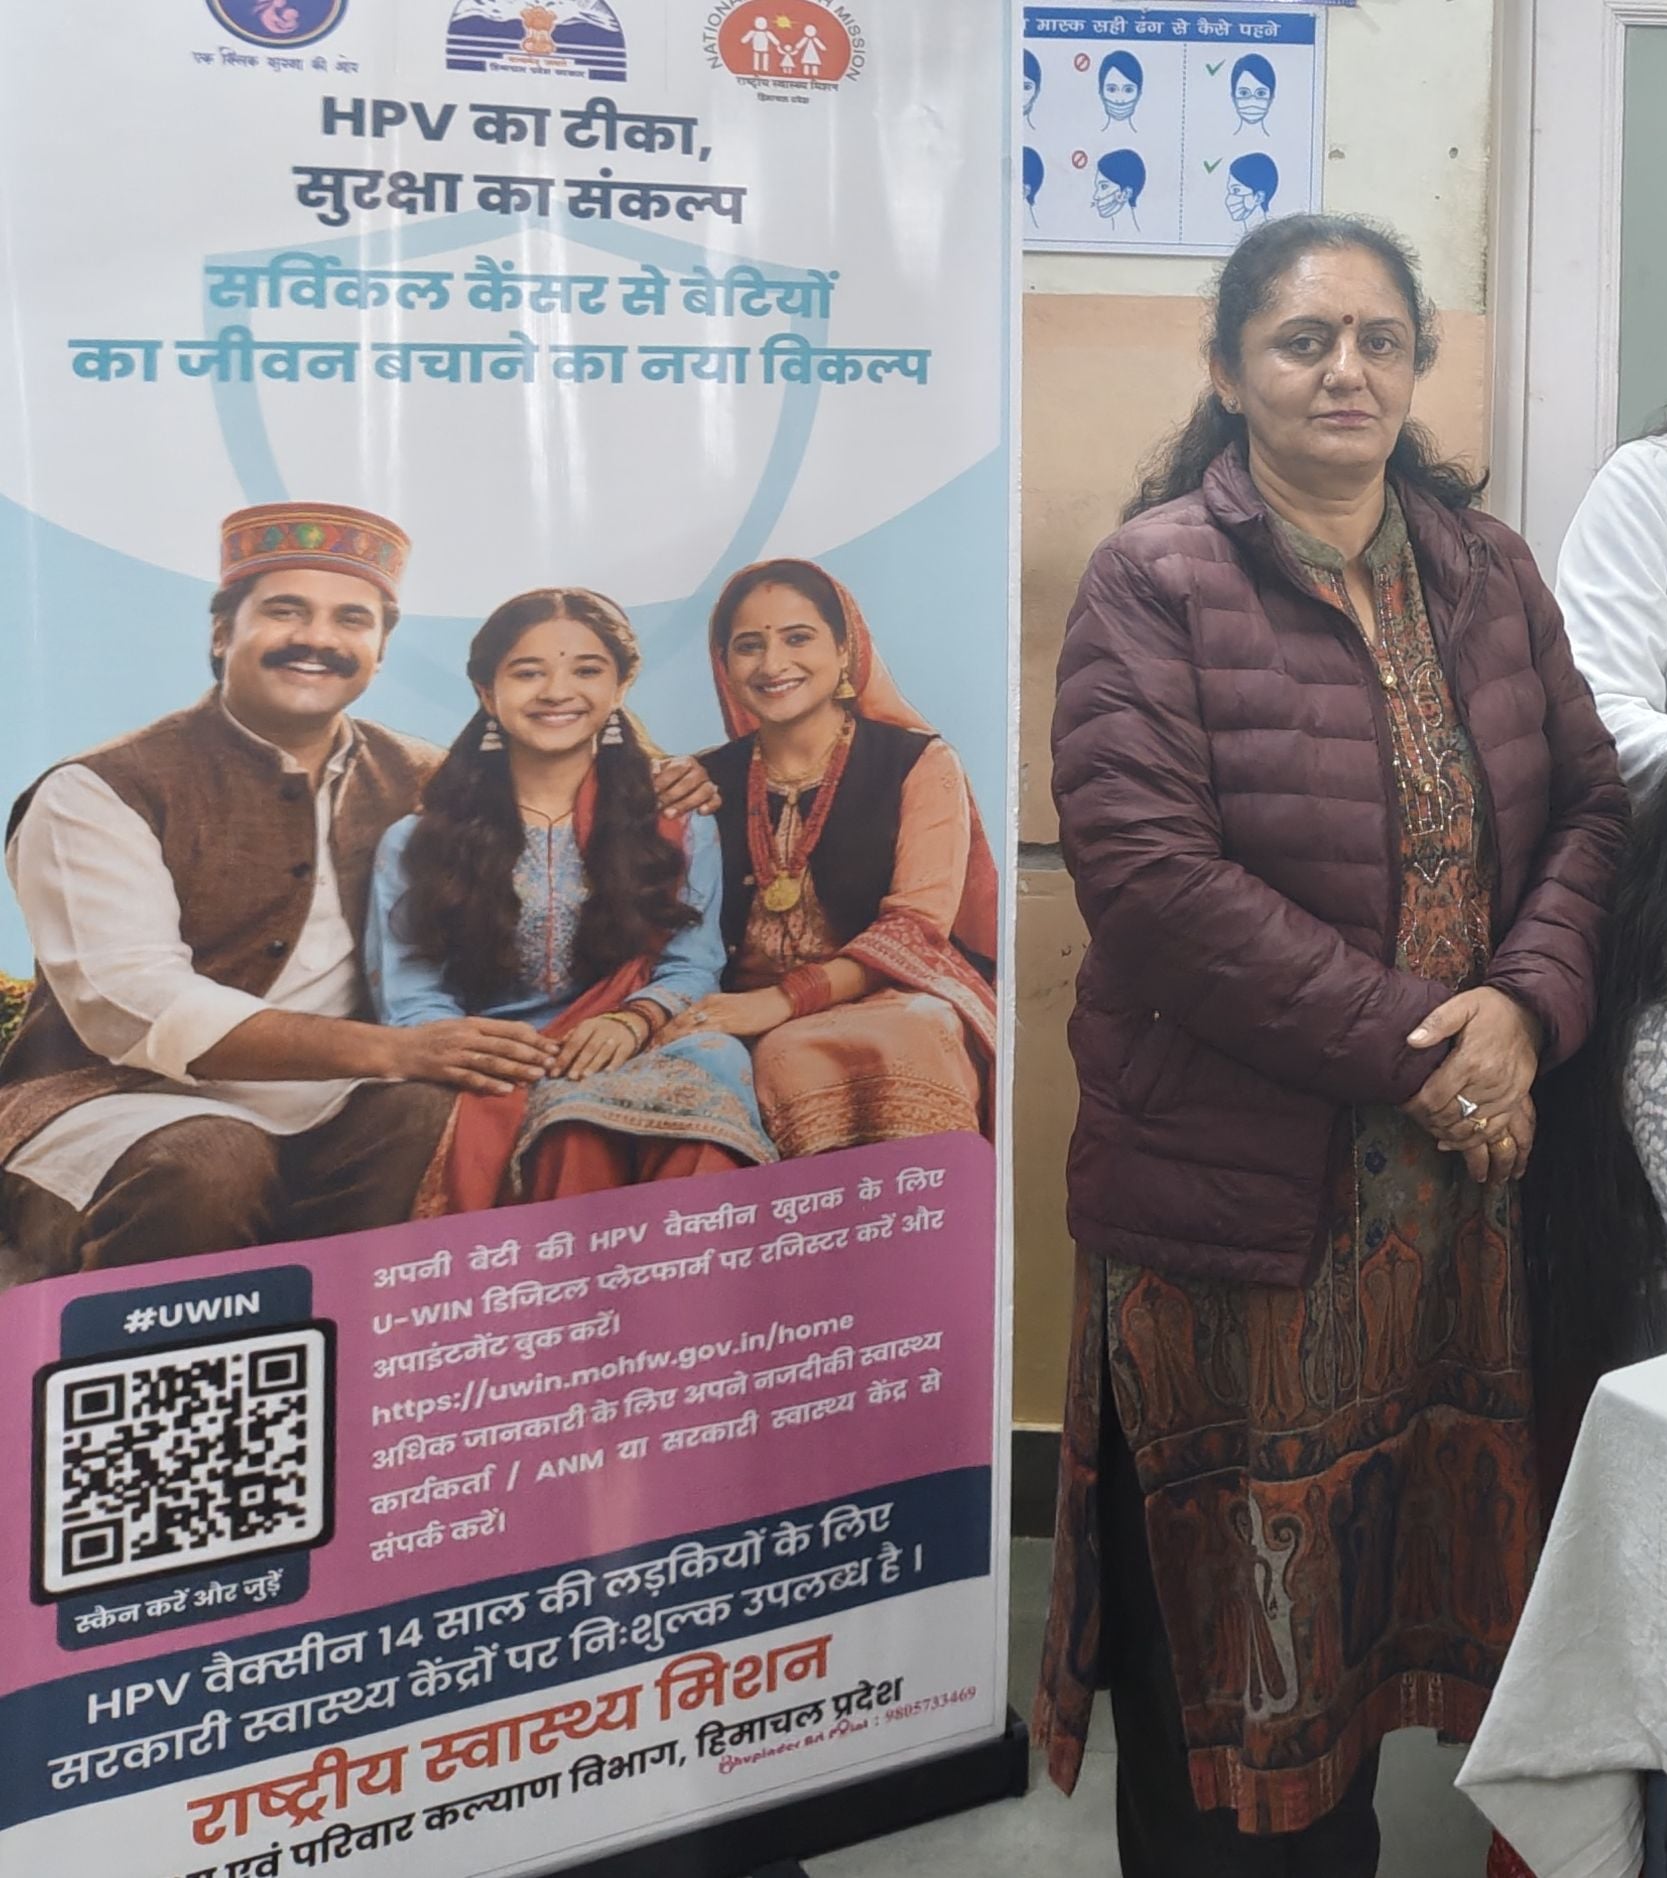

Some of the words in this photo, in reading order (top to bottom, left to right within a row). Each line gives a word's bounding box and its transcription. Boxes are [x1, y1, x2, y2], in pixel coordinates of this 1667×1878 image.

[1036, 19, 1084, 33] मास्क
[1093, 17, 1128, 34] सही
[1135, 16, 1164, 35] ढंग
[1172, 18, 1190, 35] से
[1197, 16, 1231, 37] कैसे
[320, 96, 457, 145] HPV
[470, 102, 551, 148] का
[563, 96, 712, 162] टीका,
[292, 163, 462, 228] सुरक्षा
[474, 171, 561, 218] का
[567, 165, 747, 226] संकल्प
[205, 251, 454, 310] सर्विकल
[464, 254, 611, 317] कैंसर
[620, 263, 668, 317] से
[681, 266, 842, 322] बेटियों
[68, 339, 163, 382] का
[174, 324, 361, 383] जीवन
[370, 330, 539, 384] बचाने
[554, 339, 630, 386] का
[639, 341, 747, 387] नया
[762, 333, 932, 389] विकल्प
[372, 1297, 473, 1335] U-WIN
[481, 1277, 590, 1315] डिजिटल
[596, 1247, 717, 1291] प्लेटफार्म
[719, 1247, 754, 1271] पर
[761, 1227, 850, 1265] रजिस्टर
[855, 1212, 897, 1243] करें
[901, 1205, 945, 1234] और
[373, 1250, 453, 1289] अपनी
[468, 1240, 521, 1271] बेटी
[535, 1231, 575, 1261] की
[589, 1223, 649, 1253] HPV
[663, 1202, 758, 1238] वैक्सीन
[771, 1187, 845, 1224] खुराक
[857, 1176, 883, 1201] के
[896, 1166, 946, 1196] लिए
[123, 1291, 260, 1335] #UWIN
[373, 1332, 509, 1379] अपाइंटमेंट
[513, 1325, 565, 1360] बुक
[371, 1313, 855, 1427] https://uwin.mohfw.gov.in/home
[372, 1433, 457, 1471] अधिक
[462, 1402, 588, 1448] जानकारी
[591, 1398, 619, 1425] के
[624, 1387, 678, 1418] लिए
[684, 1371, 750, 1406] अपने
[753, 1345, 854, 1392] नजदीकी
[859, 1331, 944, 1367] स्वास्थ्य
[370, 1463, 497, 1517] कार्यकर्ता
[506, 1461, 521, 1491] /
[534, 1449, 605, 1483] ANM
[617, 1436, 649, 1462] या
[661, 1409, 759, 1454] सरकारी
[770, 1391, 857, 1430] स्वास्थ्य
[867, 1377, 909, 1406] केंद्र
[920, 1367, 943, 1394] से
[370, 1520, 446, 1563] संपर्क
[87, 1671, 191, 1726] HPV
[202, 1630, 369, 1695] वैक्सीन
[377, 1616, 424, 1657] 14
[434, 1589, 530, 1640] साल
[535, 1568, 598, 1615] की
[603, 1535, 766, 1600] लड़कियों
[772, 1520, 814, 1559] के
[819, 1501, 895, 1549] लिए
[145, 1588, 190, 1617] करें
[193, 1581, 239, 1608] और
[242, 1568, 284, 1602] जुड़ें
[47, 1709, 233, 1791] सरकारी
[239, 1675, 401, 1744] स्वास्थ्य
[408, 1642, 504, 1701] केंद्रों
[504, 1634, 563, 1675] पर
[570, 1597, 734, 1661] निःशुल्क
[741, 1556, 871, 1618] उपलब्ध
[877, 1541, 914, 1585] है
[186, 1746, 408, 1847] राष्ट्रीय
[420, 1682, 646, 1785] स्वास्थ्य
[653, 1634, 835, 1722] मिशन
[289, 1812, 416, 1868] परिवार
[424, 1770, 563, 1835] कल्याण
[569, 1737, 688, 1791] विभाग,
[695, 1696, 825, 1759] हिमाचल
[832, 1674, 905, 1721] प्रदेश
